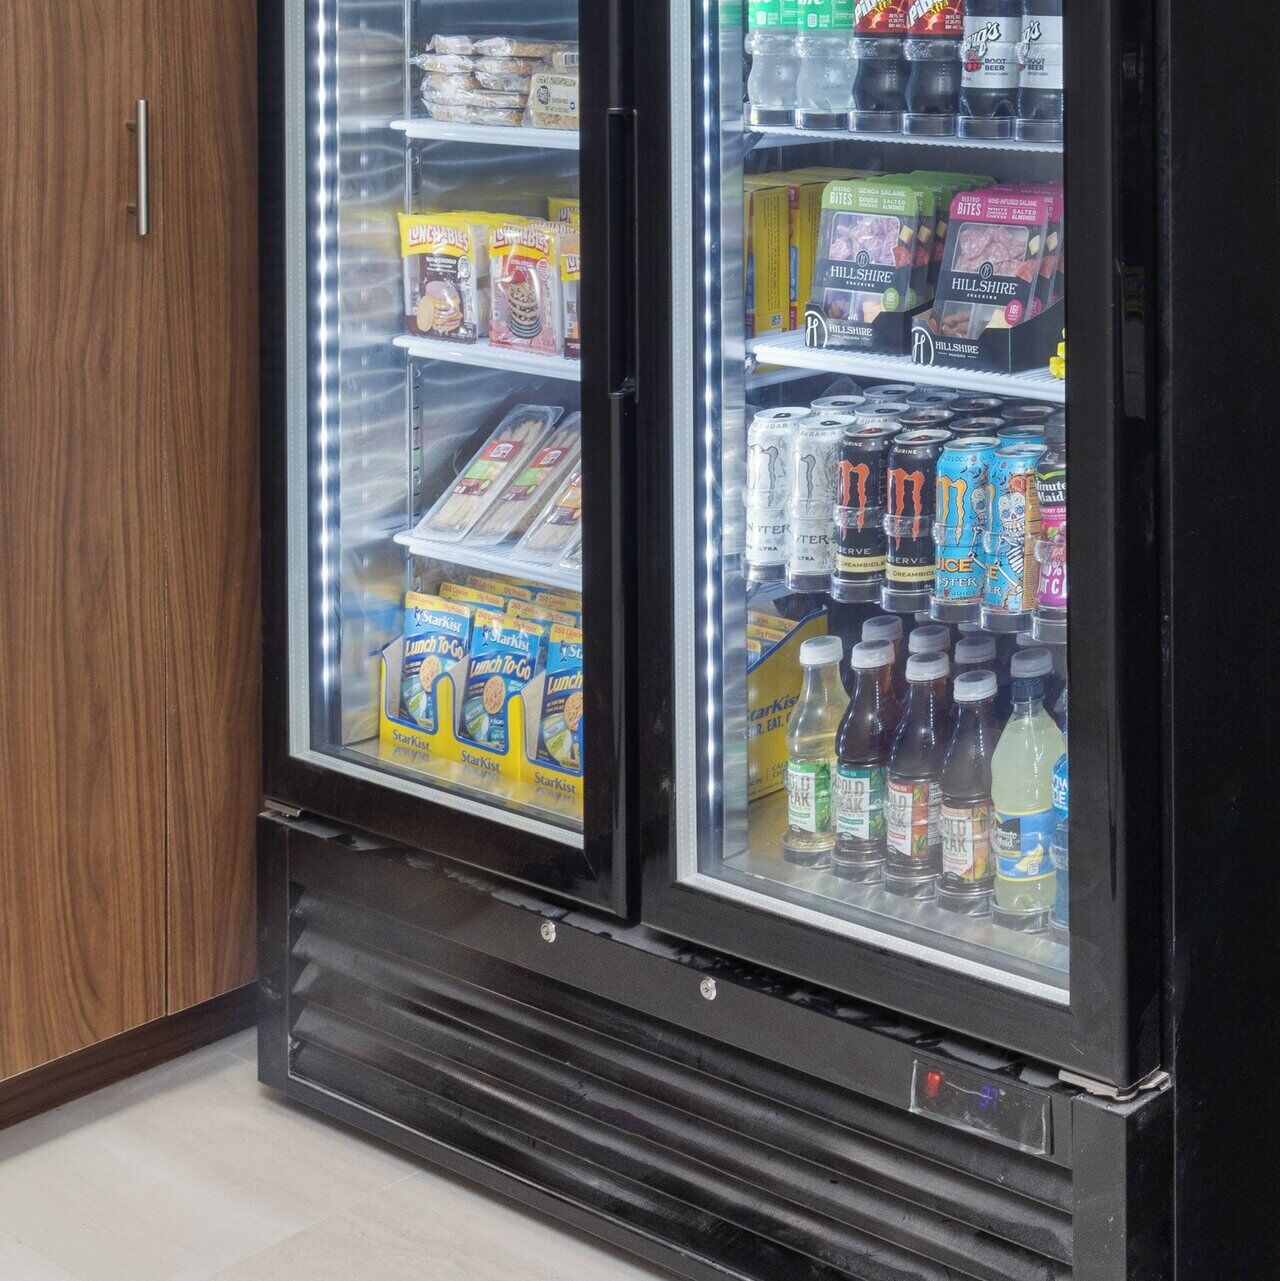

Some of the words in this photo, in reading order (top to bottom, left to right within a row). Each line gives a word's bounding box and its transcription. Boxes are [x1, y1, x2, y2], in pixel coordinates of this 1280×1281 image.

[858, 187, 878, 195] GENOA
[880, 189, 906, 197] SALAME
[408, 225, 469, 252] LUNCHABLES
[830, 265, 893, 284] HILLSHIRE
[951, 277, 1018, 296] HILLSHIRE
[829, 324, 872, 337] HILLSHIRE
[935, 341, 979, 355] HILLSHIRE
[422, 611, 462, 633] StarKist
[405, 637, 435, 655] Lunch
[491, 632, 530, 650] StarKist
[470, 659, 502, 676] Lunch
[392, 727, 431, 753] StarKist
[461, 750, 499, 772] StarKist
[535, 772, 577, 794] StarKist
